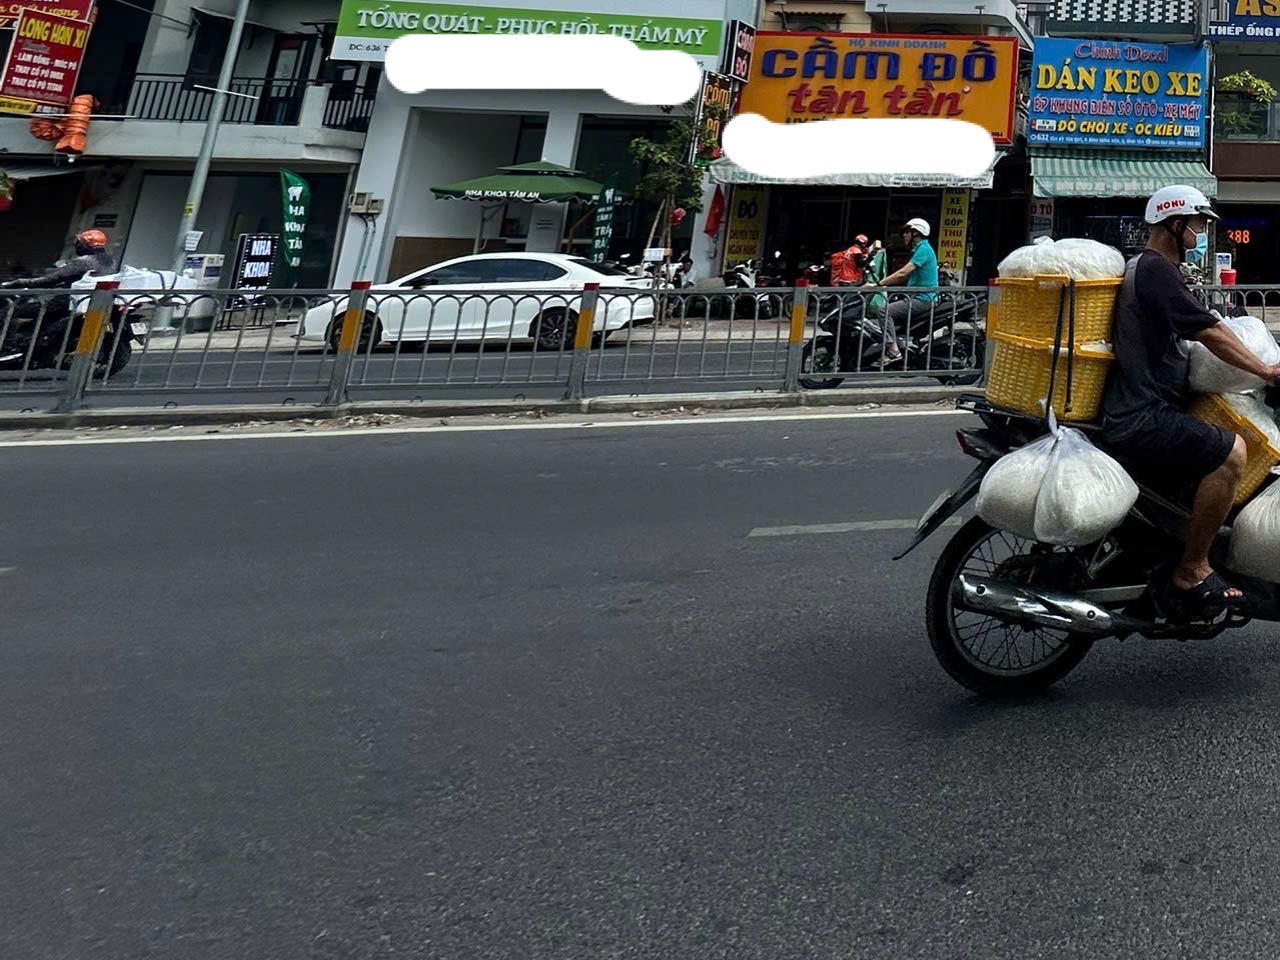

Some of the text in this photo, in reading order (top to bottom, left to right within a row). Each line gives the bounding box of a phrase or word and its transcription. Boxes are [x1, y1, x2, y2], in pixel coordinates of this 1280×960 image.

[357, 4, 420, 30] TỔNG
[422, 12, 484, 34] QUÁT
[19, 17, 51, 41] LONG
[1209, 23, 1244, 36] THÉP
[1246, 22, 1274, 37] ỐNG
[848, 38, 948, 49] HỘ KINH DOANH
[762, 36, 998, 82] CẦM ĐỒ
[1125, 44, 1168, 62] Decal
[1036, 58, 1202, 97] DÁN KEO XE
[1179, 100, 1202, 120] MÁY
[1057, 114, 1076, 132] ĐỒ
[1112, 122, 1128, 134] XE
[1135, 117, 1152, 135] ỐC
[465, 189, 483, 197] NHA
[484, 190, 507, 198] KHOA
[526, 191, 540, 199] AN
[950, 197, 961, 205] XE
[944, 229, 962, 237] THU
[251, 240, 271, 256] NHA
[940, 239, 963, 248] MUA
[944, 250, 958, 259] XE
[243, 262, 270, 278] KHOA
